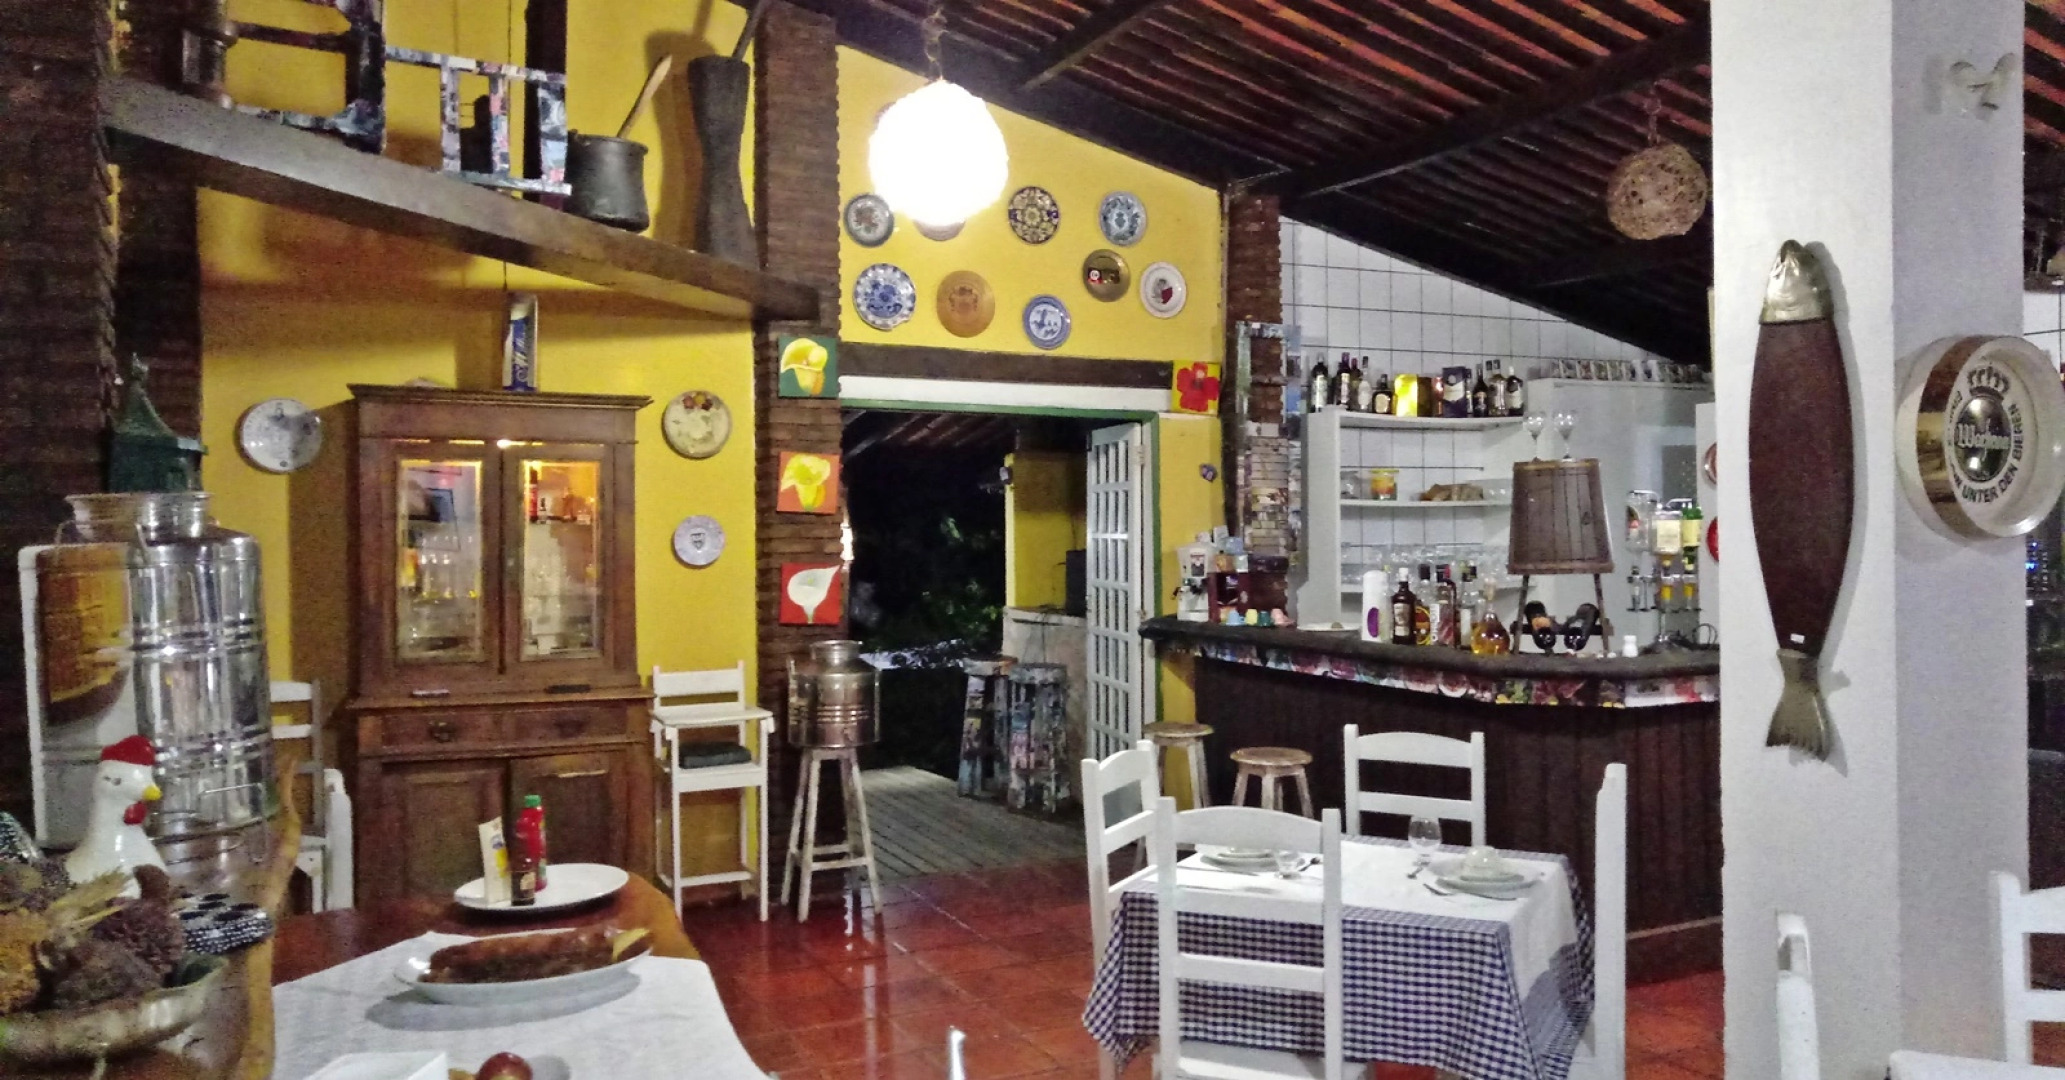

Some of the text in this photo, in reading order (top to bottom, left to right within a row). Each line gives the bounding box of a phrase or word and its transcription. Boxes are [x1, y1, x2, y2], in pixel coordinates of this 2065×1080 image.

[1962, 404, 2023, 503] UNTER DEN BIEREN
